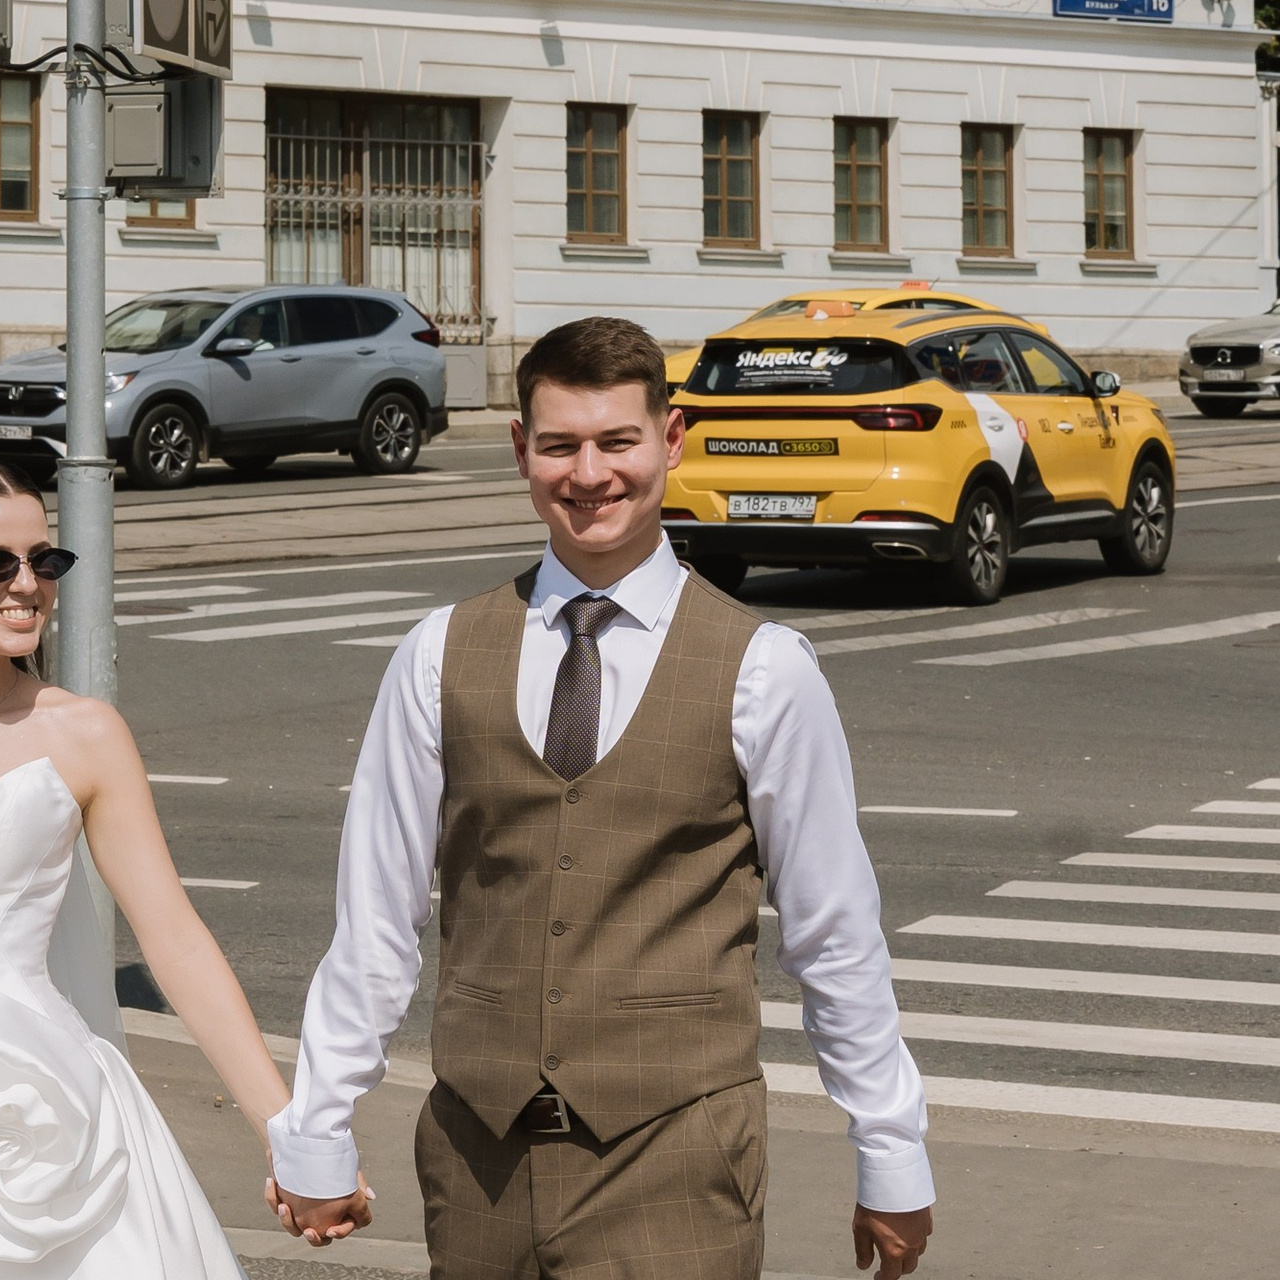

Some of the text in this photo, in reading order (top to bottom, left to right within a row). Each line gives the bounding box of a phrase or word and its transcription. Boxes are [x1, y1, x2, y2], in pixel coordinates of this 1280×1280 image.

[735, 351, 812, 368] Яндекс
[708, 441, 779, 454] ШОКОЛАД
[733, 496, 812, 511] В182ТВ 797
